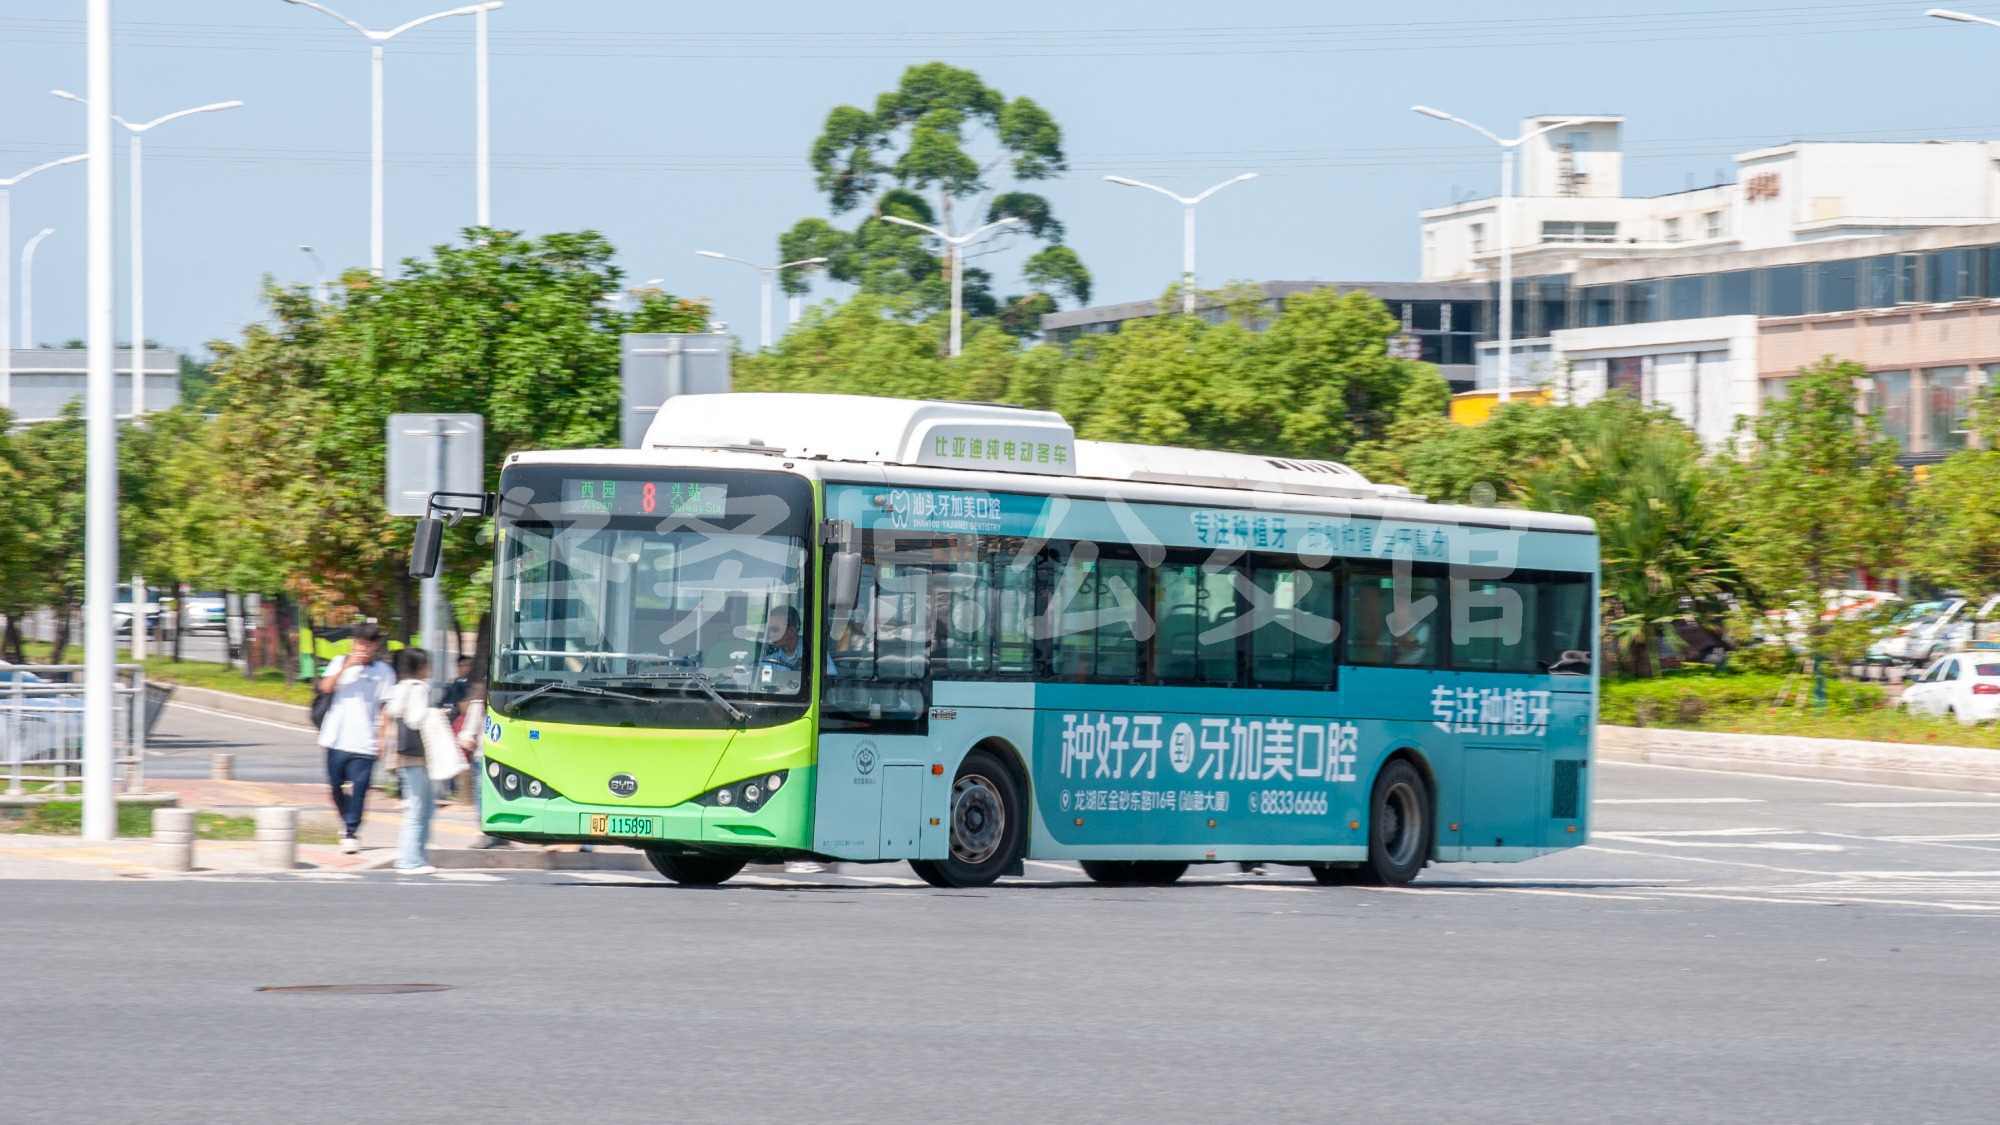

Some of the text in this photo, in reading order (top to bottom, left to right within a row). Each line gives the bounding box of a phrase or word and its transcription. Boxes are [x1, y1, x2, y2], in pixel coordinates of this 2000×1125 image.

[935, 436, 1067, 464] 比亚迪纯电动客车
[581, 481, 616, 499] 西园
[643, 482, 656, 512] 8
[912, 493, 1001, 519] 汕头牙加美口腔
[913, 519, 940, 529] SHANTOU
[971, 522, 1001, 532] DENTISTRY
[1194, 513, 1287, 548] 专注种植牙
[1430, 684, 1552, 737] 专注种植牙
[611, 780, 635, 791] BYD
[1260, 789, 1328, 815] 88336666
